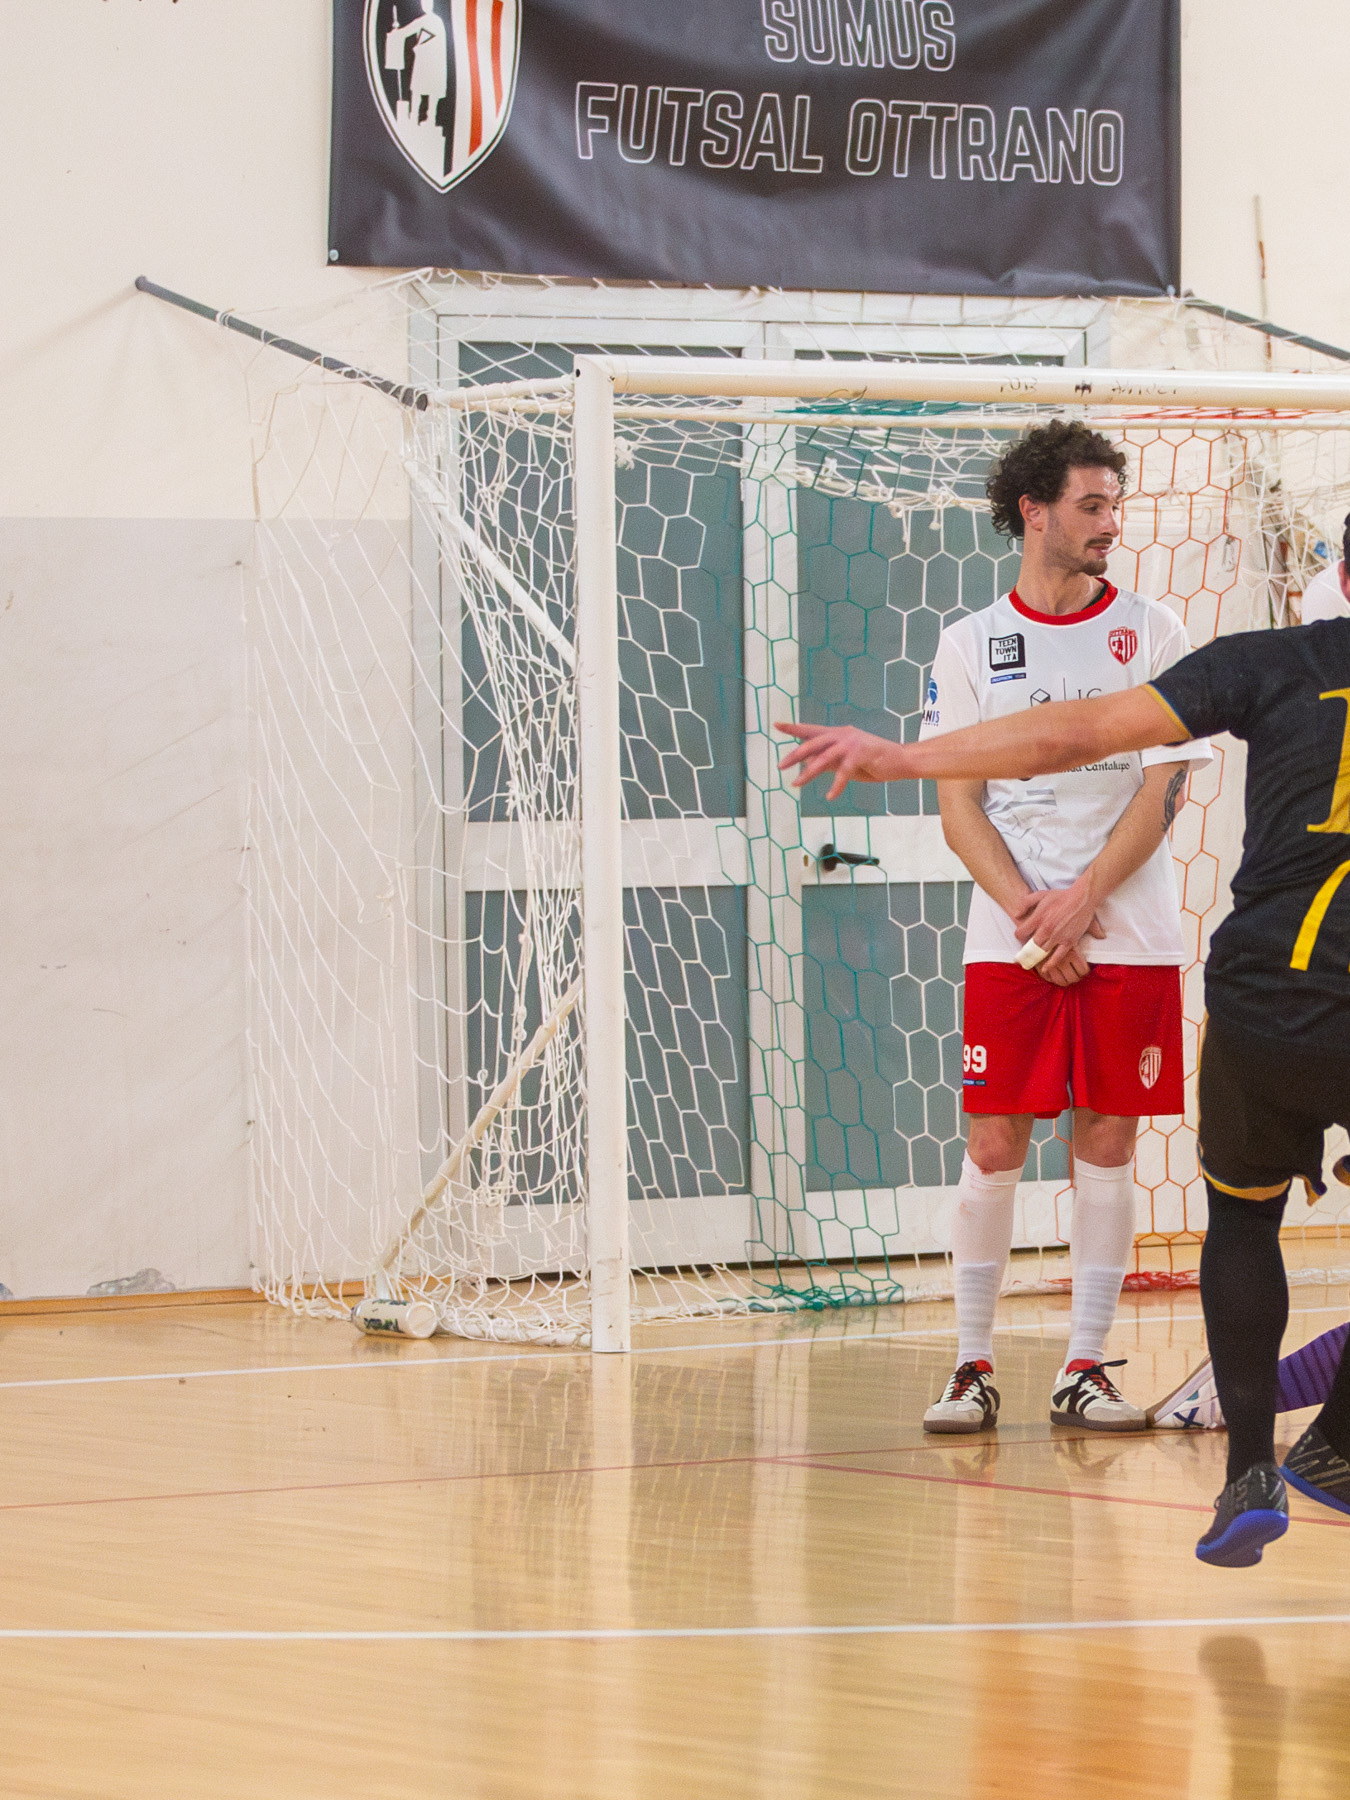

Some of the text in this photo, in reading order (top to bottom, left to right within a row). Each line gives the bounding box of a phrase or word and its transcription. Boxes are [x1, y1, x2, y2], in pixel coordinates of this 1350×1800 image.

[762, 0, 955, 72] SUMUS
[575, 81, 1124, 186] FUTSAL OTTRANO
[995, 645, 1017, 656] TOWN
[998, 637, 1017, 648] TEEN
